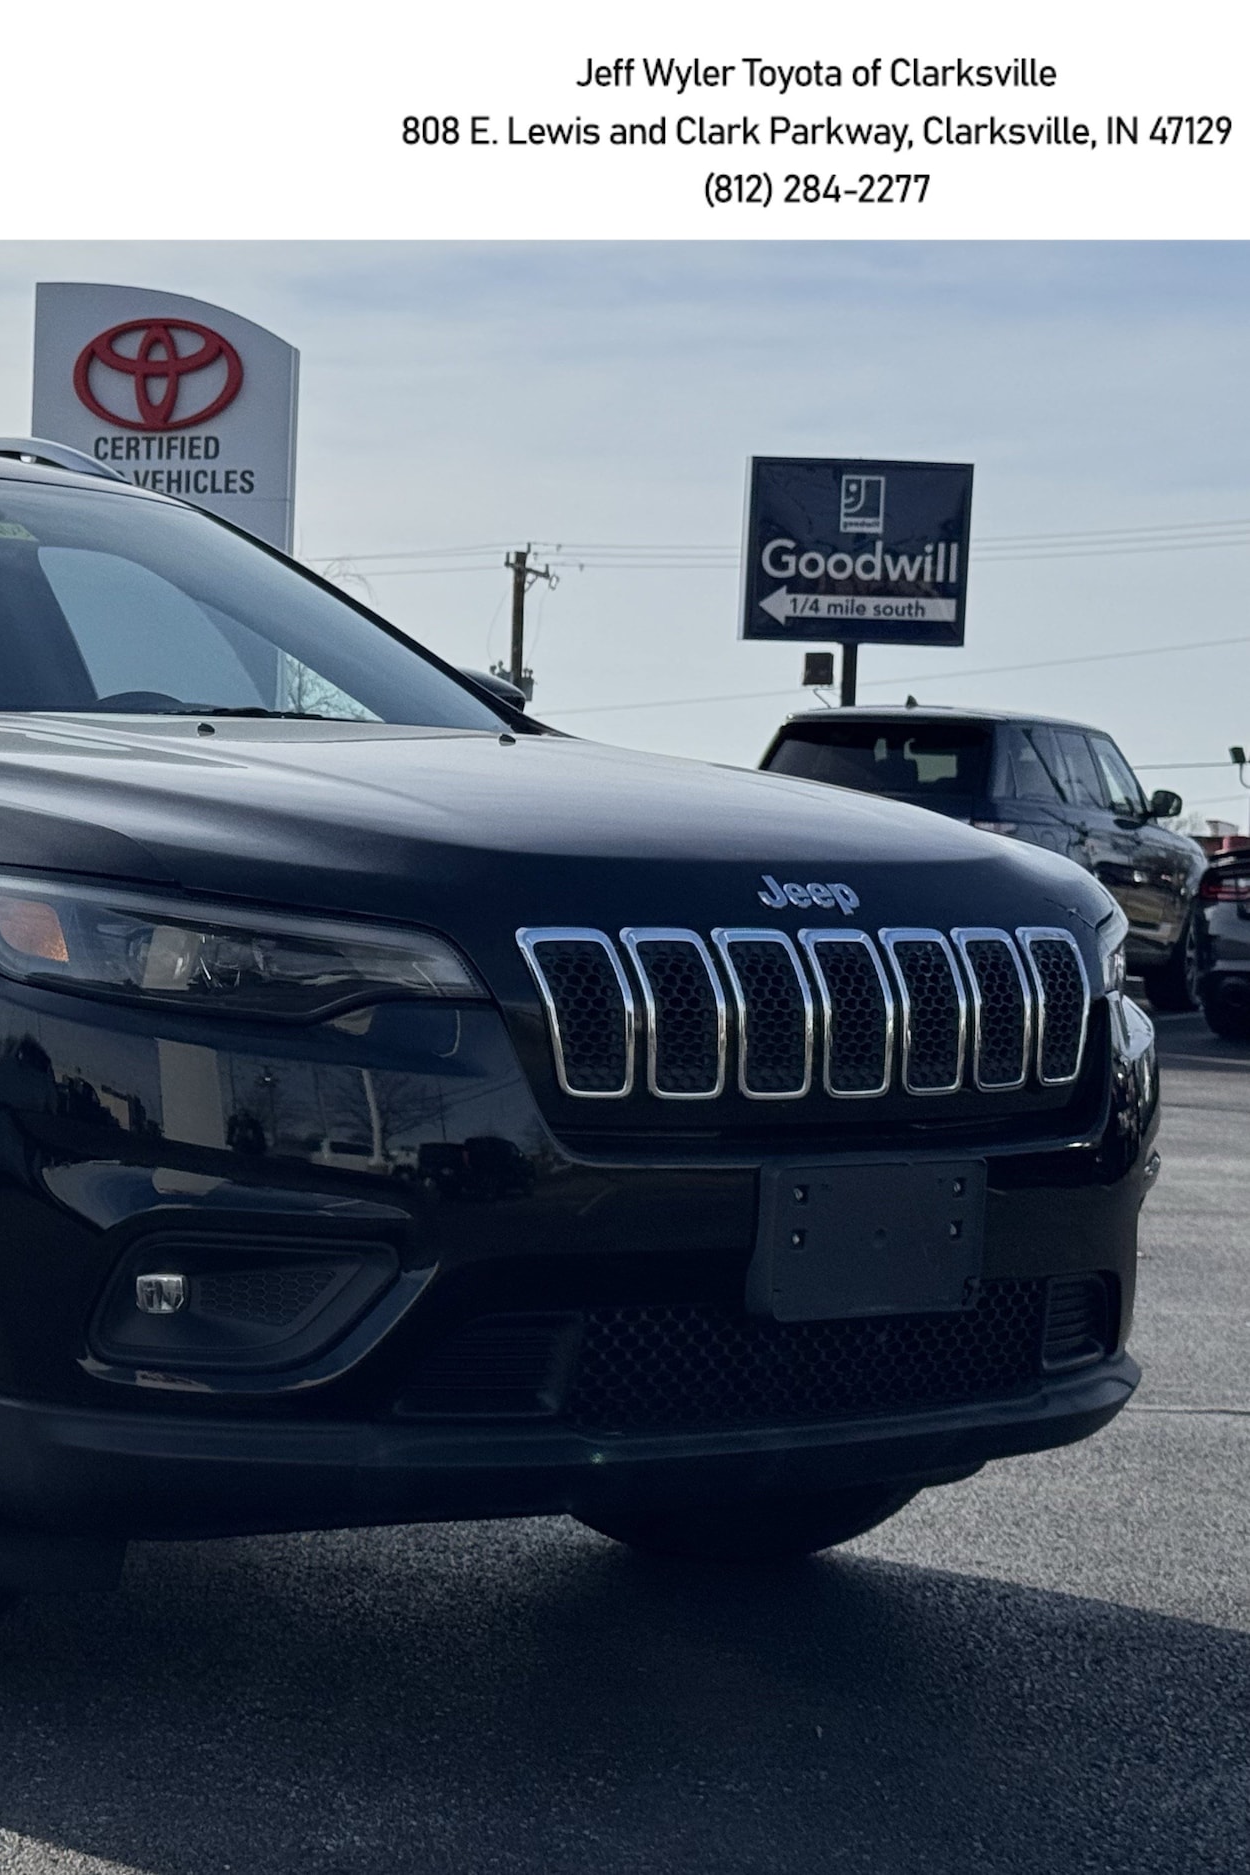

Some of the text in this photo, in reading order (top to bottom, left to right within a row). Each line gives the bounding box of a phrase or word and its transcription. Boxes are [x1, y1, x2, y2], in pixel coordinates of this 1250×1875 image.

[93, 435, 220, 461] CERTIFIED
[133, 469, 254, 494] VEHICLES
[760, 538, 959, 584] Goodwill
[789, 597, 926, 619] 1/4 mile south
[757, 874, 860, 916] Jeep
